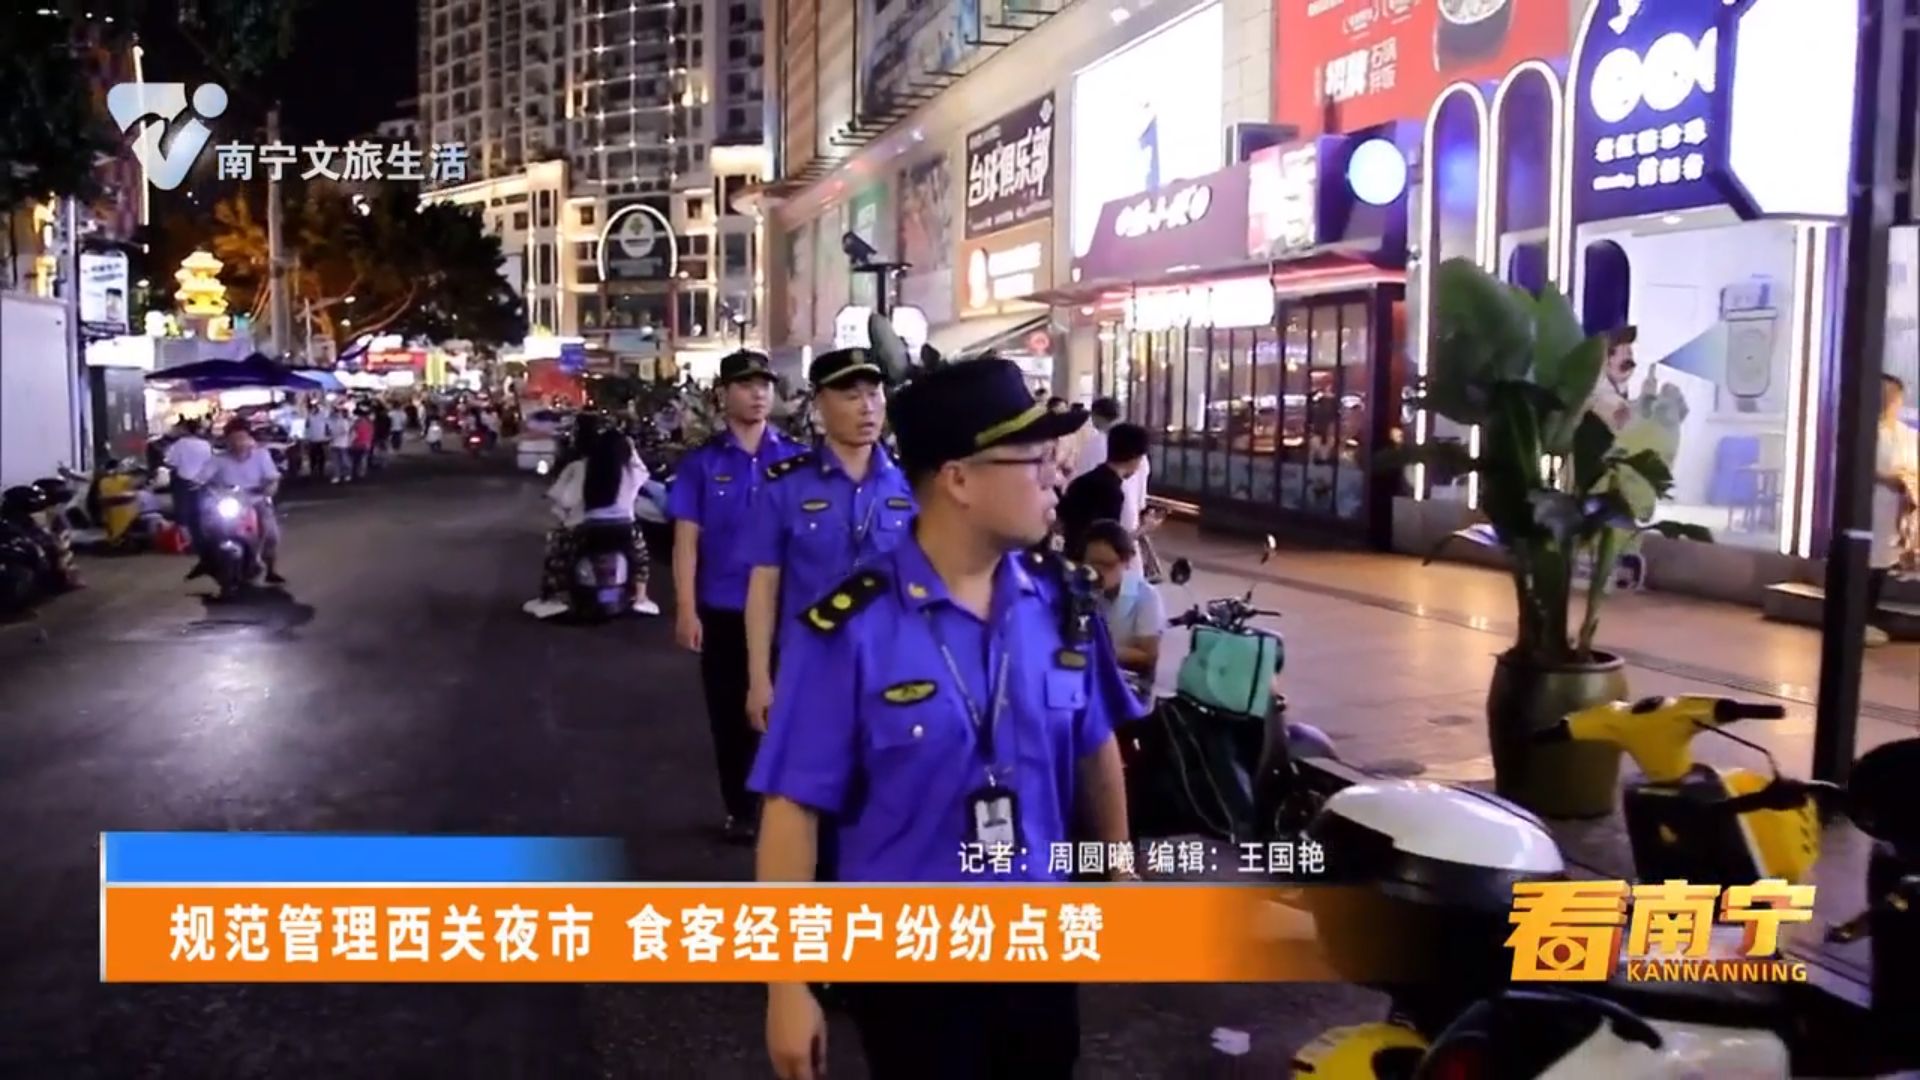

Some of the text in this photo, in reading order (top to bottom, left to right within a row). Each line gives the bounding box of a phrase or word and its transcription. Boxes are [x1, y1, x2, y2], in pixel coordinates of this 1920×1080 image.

[967, 126, 1052, 208] 台球俱乐部
